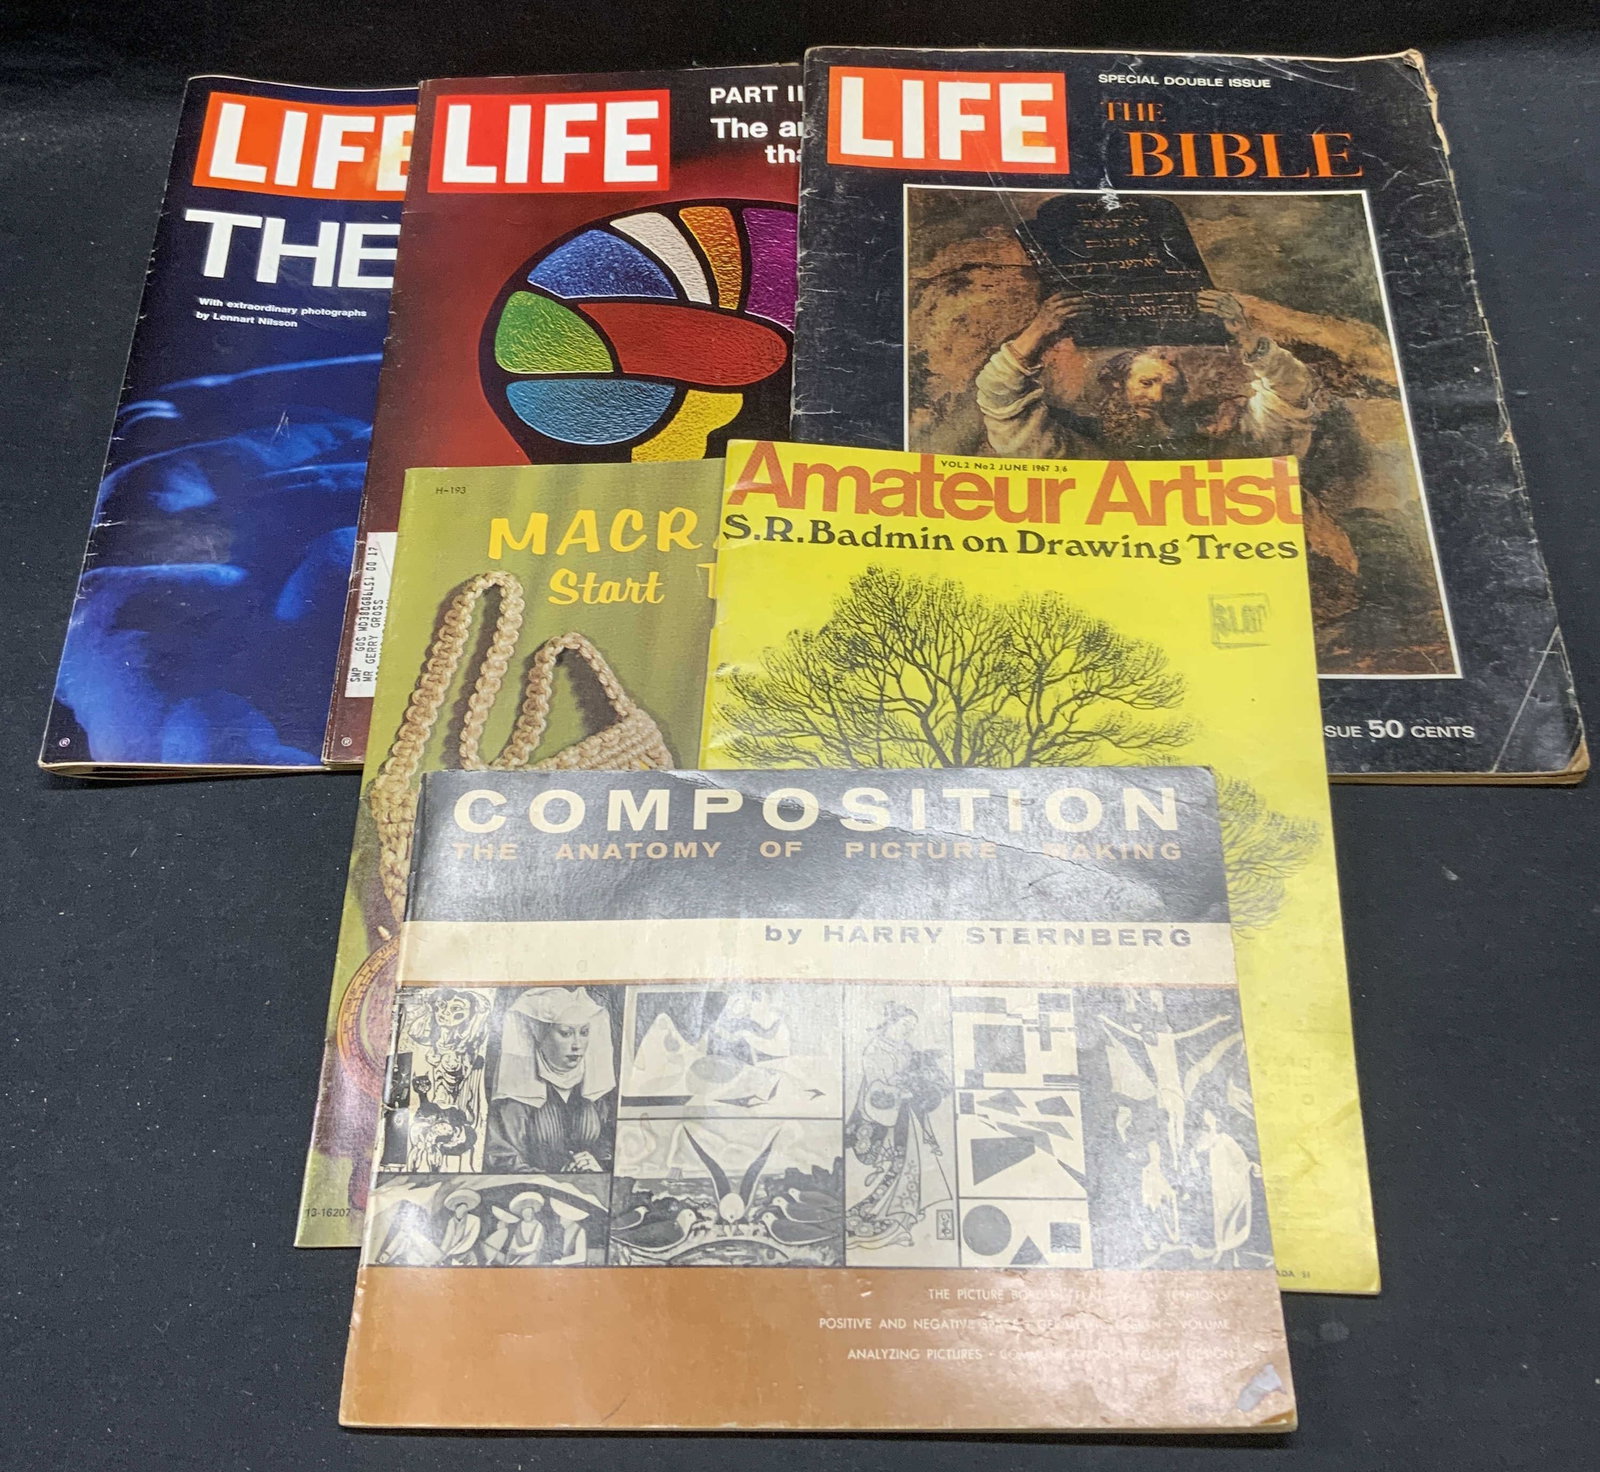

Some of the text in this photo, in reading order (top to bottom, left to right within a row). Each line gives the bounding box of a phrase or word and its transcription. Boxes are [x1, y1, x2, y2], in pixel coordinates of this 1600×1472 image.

[1098, 73, 1271, 89] SPECIAL DOUBLE ISSUE
[710, 85, 778, 104] PART
[840, 76, 1056, 164] LIFE
[1107, 101, 1166, 123] THE
[710, 117, 769, 139] The
[208, 102, 416, 192] LIFE
[442, 100, 659, 184] LIFE
[1124, 131, 1363, 178] BIBLE
[185, 208, 401, 289] THE
[199, 297, 367, 318] With extraordinary photographs
[195, 311, 298, 328] by Lennart Nilsson
[998, 464, 1028, 472] JUNE
[435, 485, 467, 495] H-193
[726, 441, 1304, 527] Amateur Artist
[963, 534, 1007, 554] on
[1018, 528, 1182, 566] Drawing
[1185, 533, 1299, 561] Trees
[548, 568, 665, 605] Start
[370, 599, 384, 628] GROSS
[365, 634, 379, 665] GERRY
[1367, 719, 1404, 740] 50
[1410, 725, 1476, 739] CENTS
[452, 787, 1180, 833] COMPOSITION
[453, 841, 1183, 861] THE ANATOMY OF PICTURE MAKING
[765, 924, 1193, 947] by HARRY STERNBERG
[928, 1288, 950, 1301] THE
[956, 1288, 1004, 1301] PICTURE
[818, 1317, 873, 1330] POSITIVE
[879, 1317, 907, 1330] AND
[913, 1318, 975, 1331] NEGATIVE
[846, 1348, 921, 1361] ANALYZING
[926, 1348, 984, 1361] PICTURES
